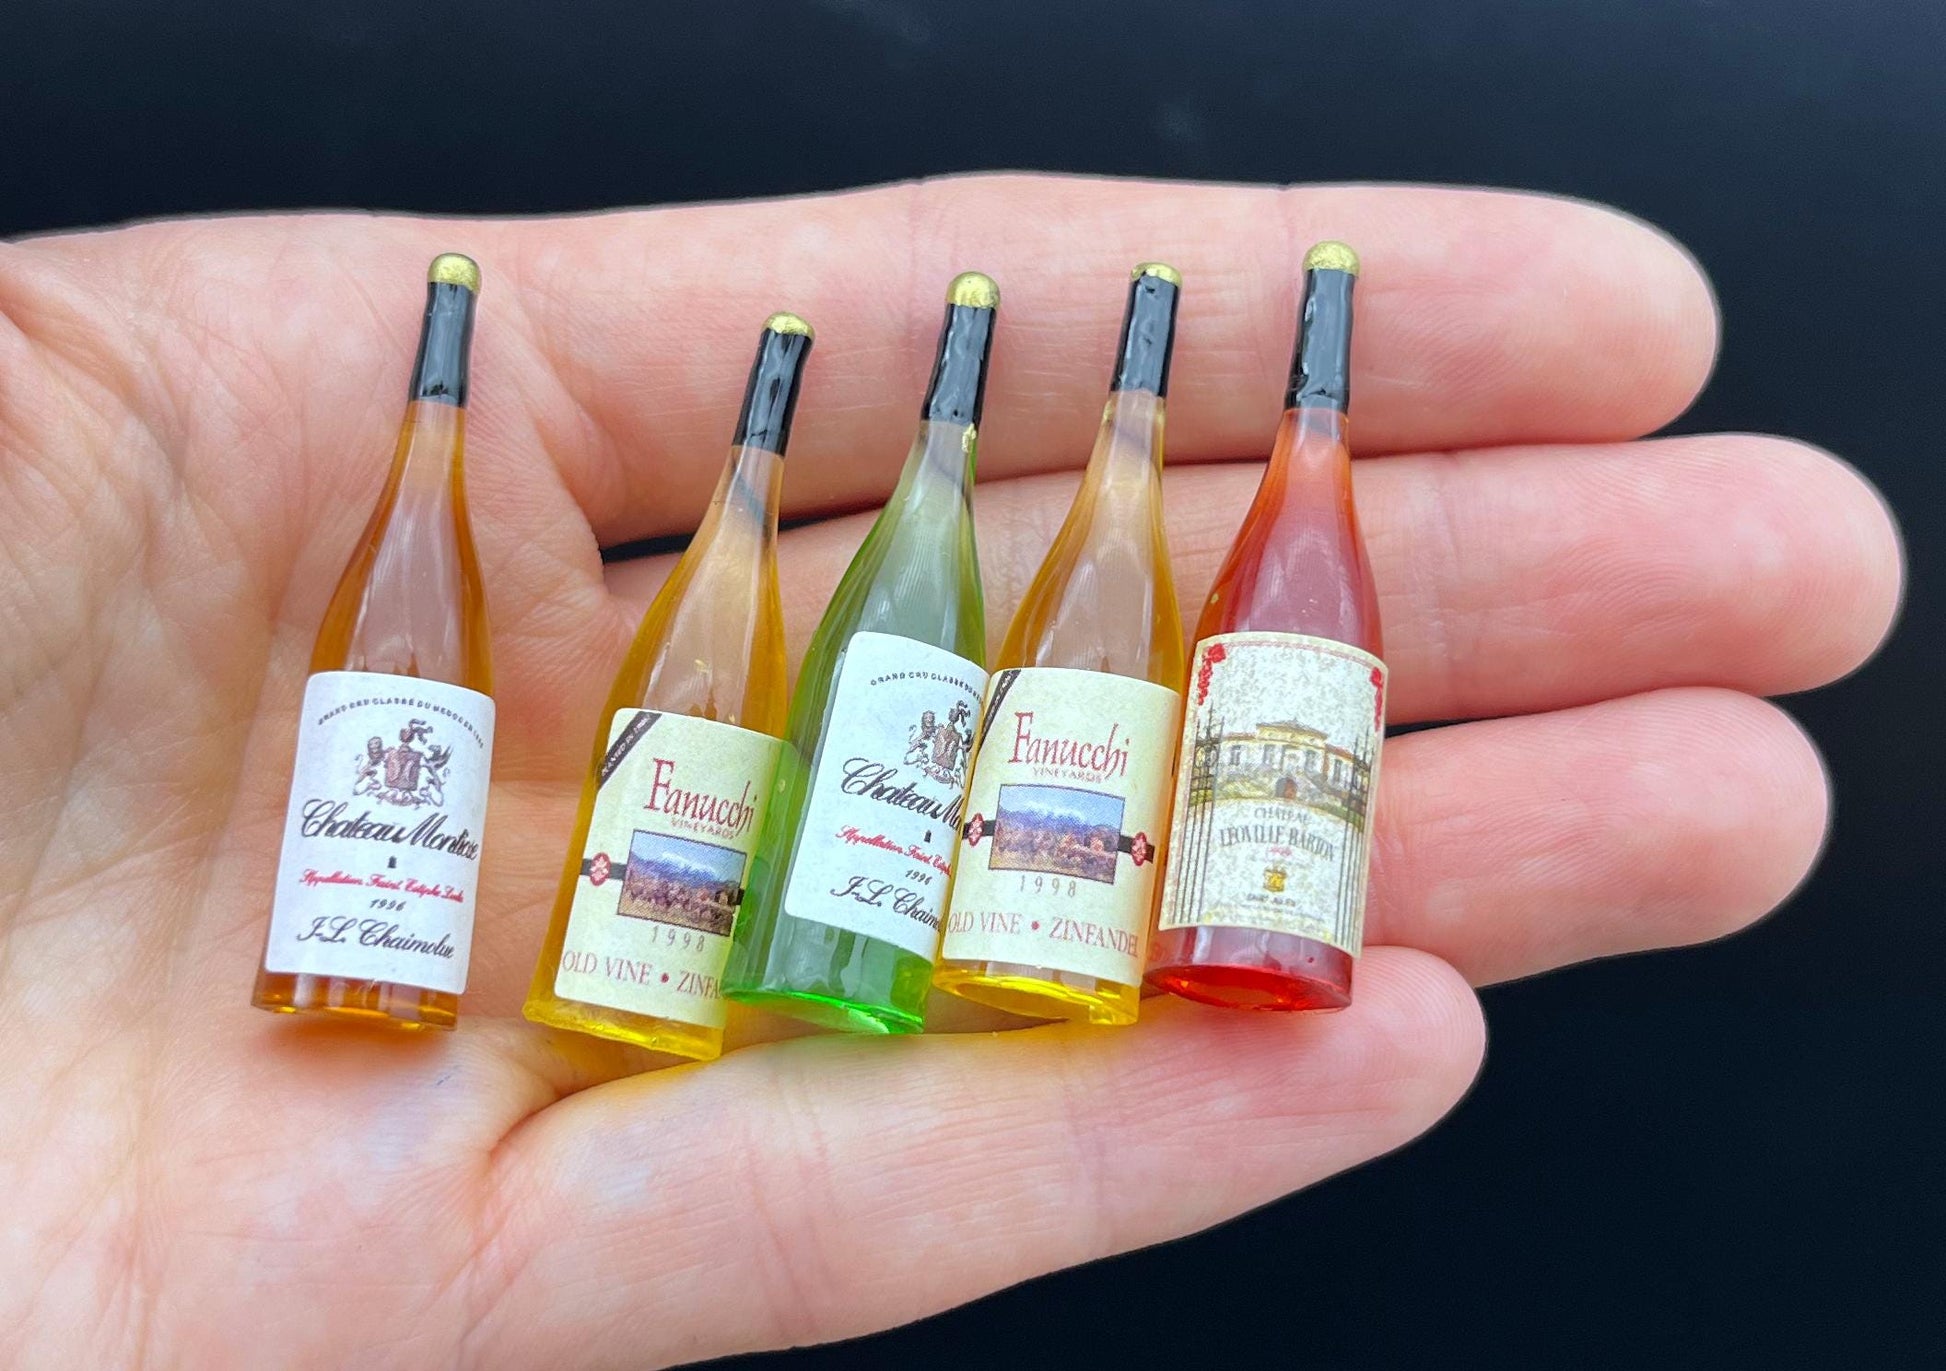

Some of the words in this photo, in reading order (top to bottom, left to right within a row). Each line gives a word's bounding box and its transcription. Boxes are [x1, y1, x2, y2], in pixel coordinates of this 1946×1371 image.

[870, 672, 906, 686] GRAND
[908, 671, 929, 680] CRU
[1008, 711, 1130, 780] Fanucchi
[1033, 766, 1101, 783] VINEYARDS
[643, 757, 757, 836] Fanucchi
[1019, 874, 1078, 899] 1998
[948, 910, 975, 935] OLD
[979, 911, 1023, 936] VINE
[651, 926, 706, 952] 1998
[562, 950, 598, 974] OLD
[605, 955, 653, 986] VINE
